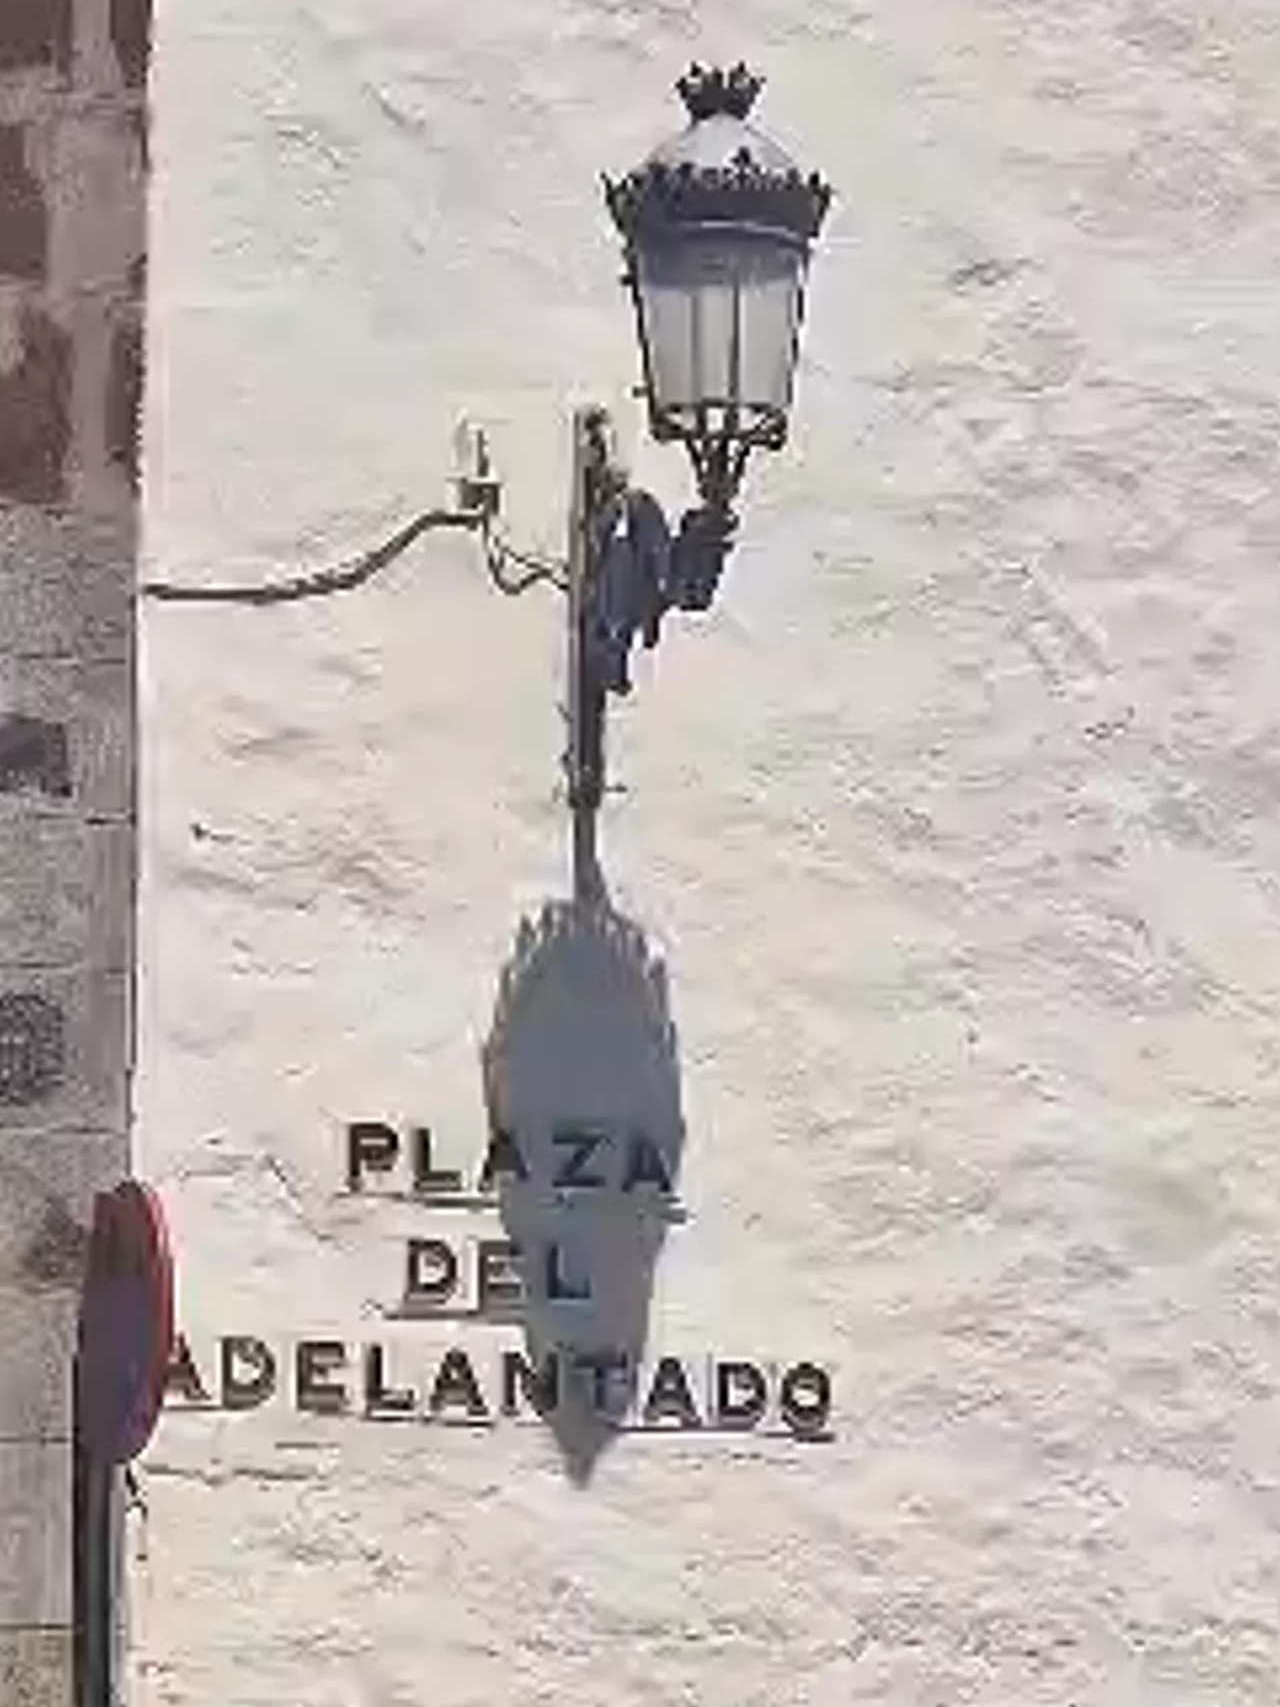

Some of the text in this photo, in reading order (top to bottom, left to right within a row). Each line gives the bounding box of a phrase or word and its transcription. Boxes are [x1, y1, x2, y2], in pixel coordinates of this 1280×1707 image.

[347, 1122, 674, 1193] PLAZA
[405, 1240, 592, 1304] DEL
[163, 1333, 831, 1432] ADELANTADO
